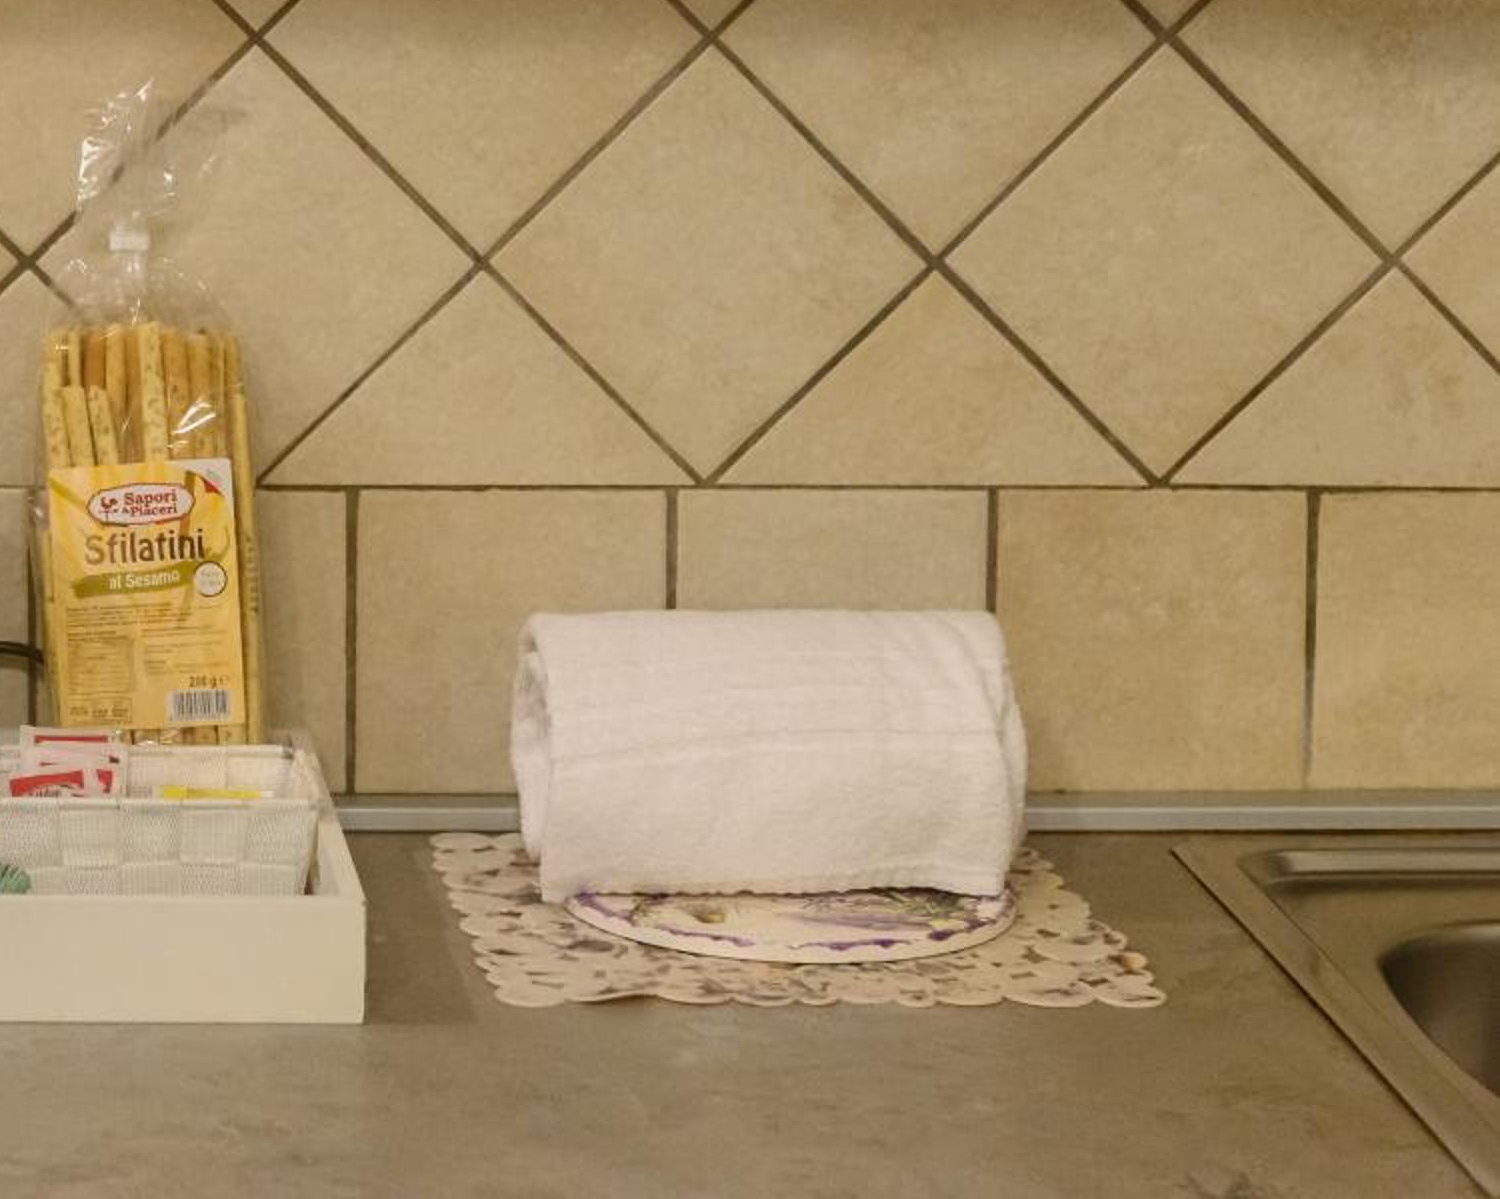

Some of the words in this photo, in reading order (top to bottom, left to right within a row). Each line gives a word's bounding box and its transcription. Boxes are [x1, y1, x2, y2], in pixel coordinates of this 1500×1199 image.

[124, 489, 178, 507] Sapori
[129, 503, 178, 517] Piaceri
[85, 528, 206, 565] Sfilatini
[109, 576, 122, 589] al
[125, 570, 181, 589] Sesamo
